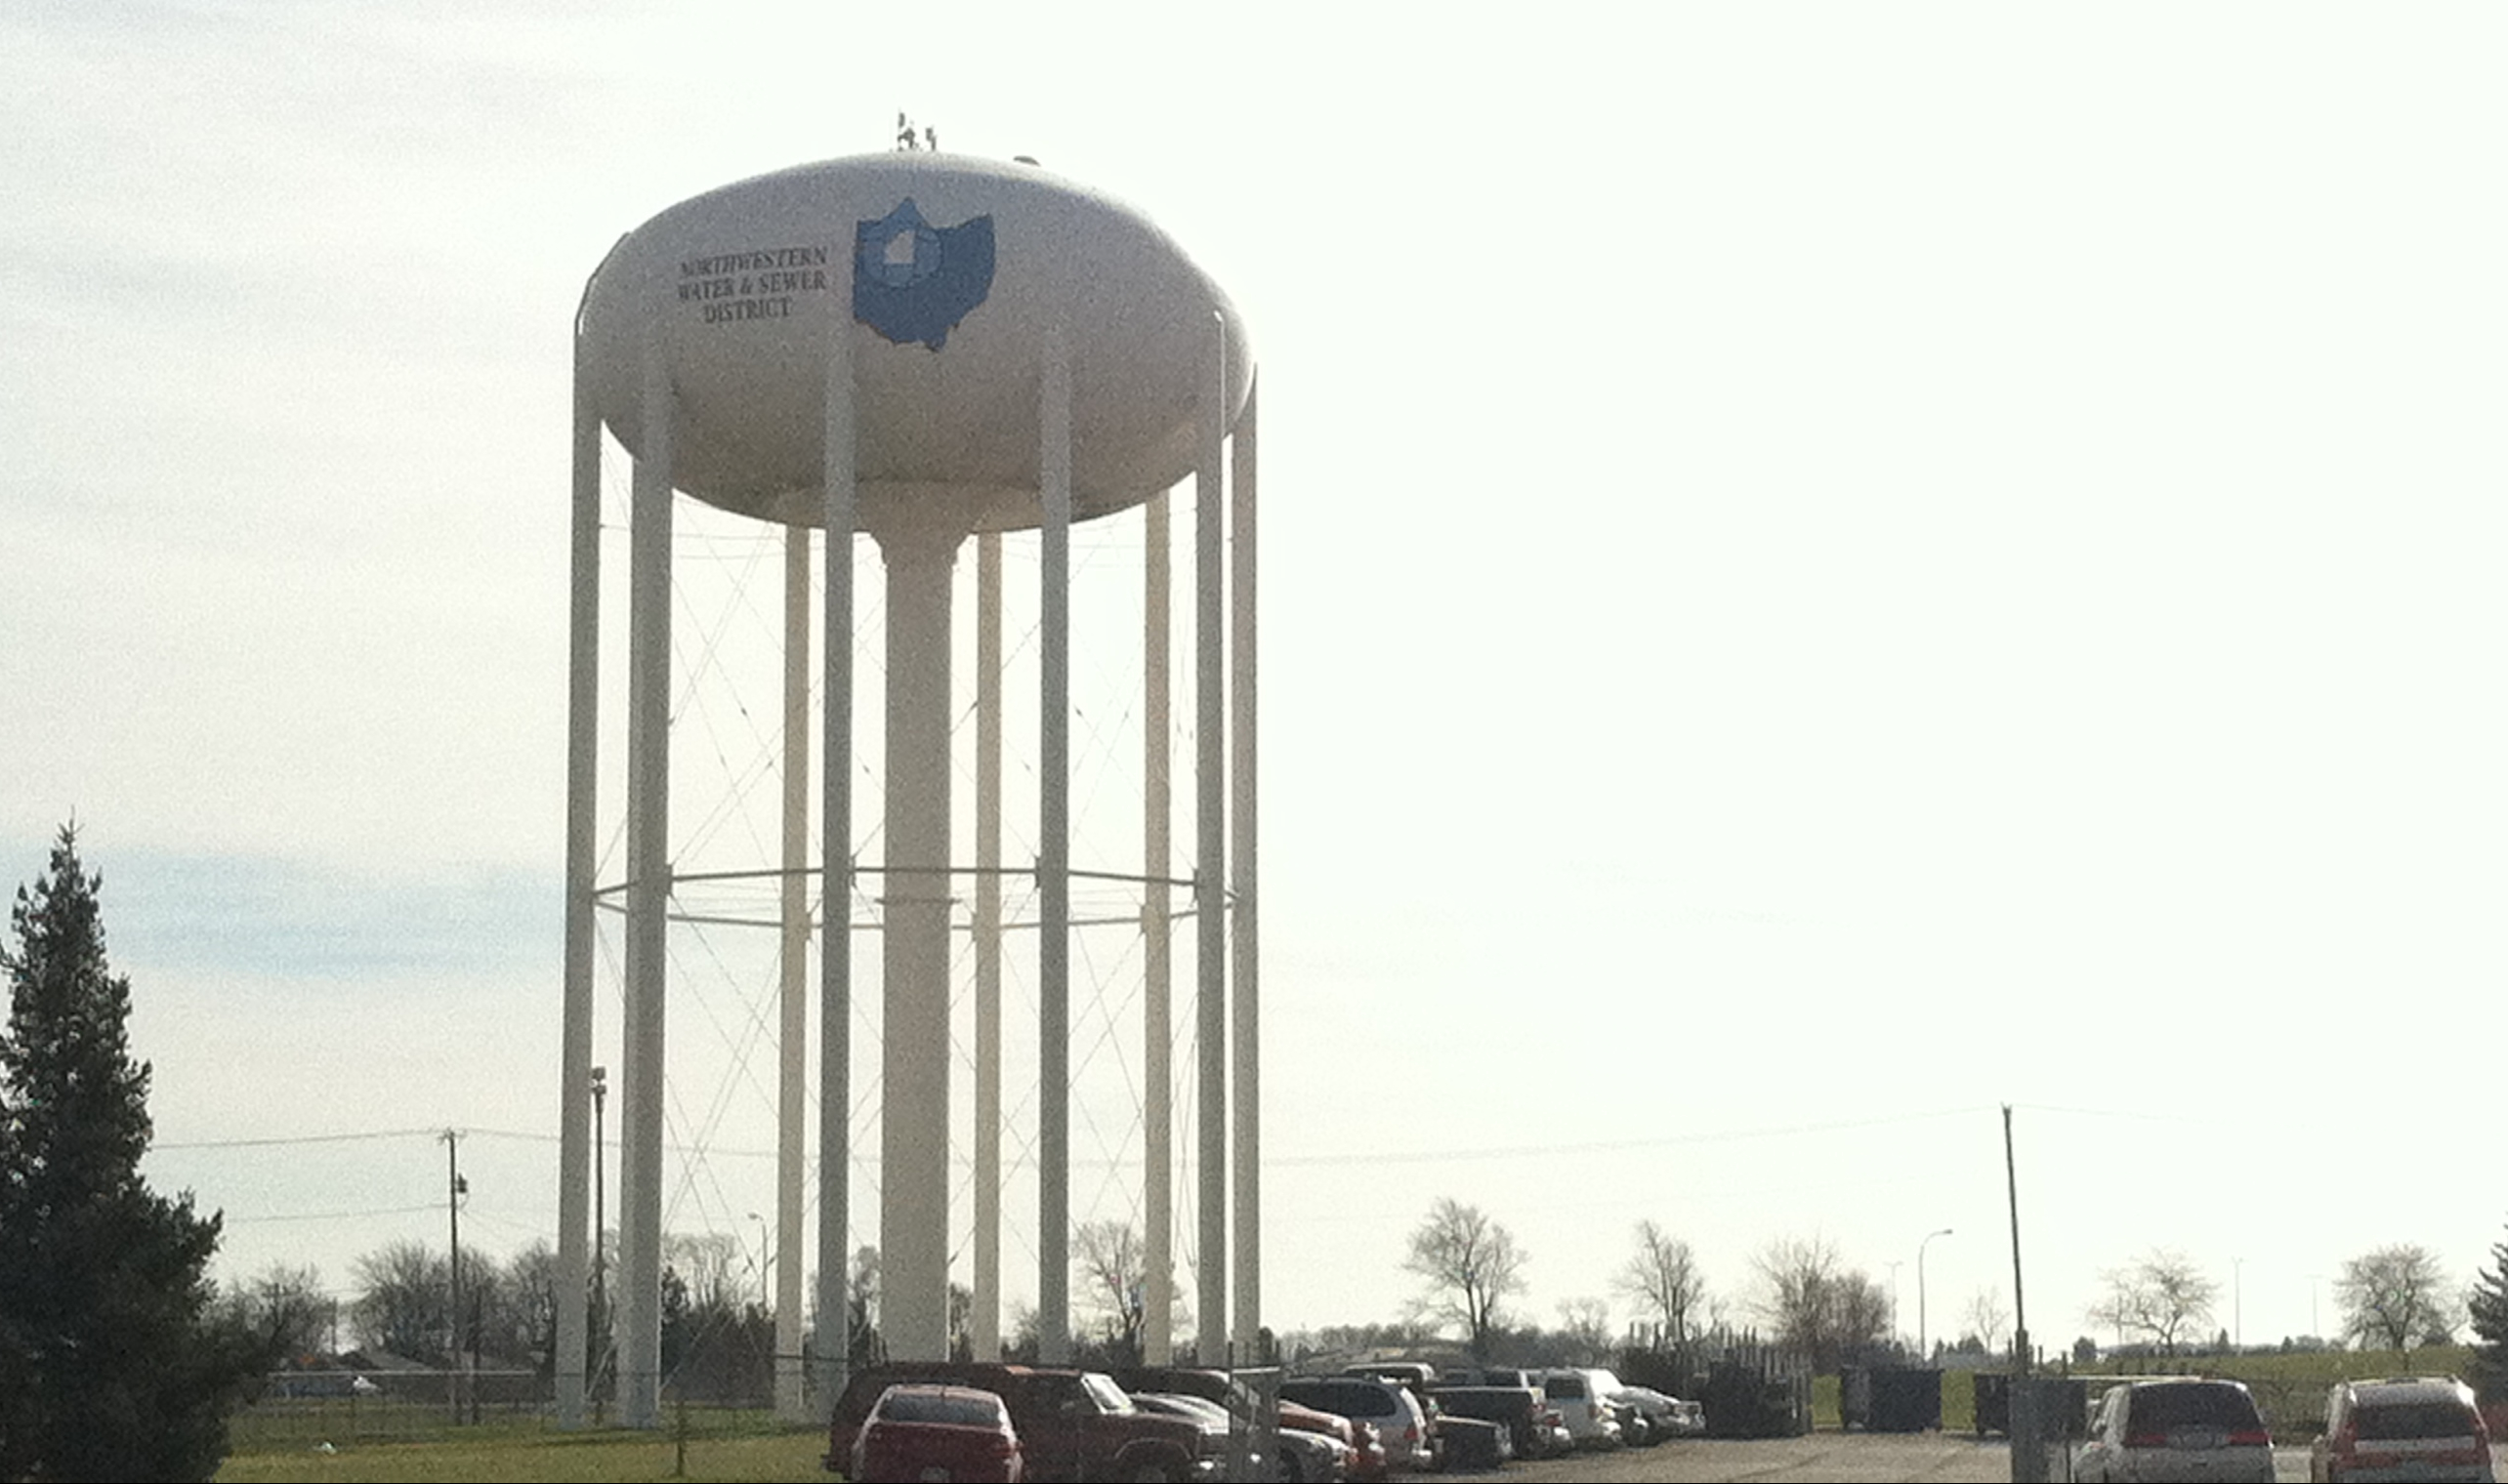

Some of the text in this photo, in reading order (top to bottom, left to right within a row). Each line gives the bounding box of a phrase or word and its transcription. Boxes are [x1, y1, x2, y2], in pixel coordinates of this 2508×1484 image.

[681, 246, 827, 276] NORTHWESTERN
[678, 269, 827, 301] WATER & SEWER
[704, 296, 793, 323] DISTRICT
